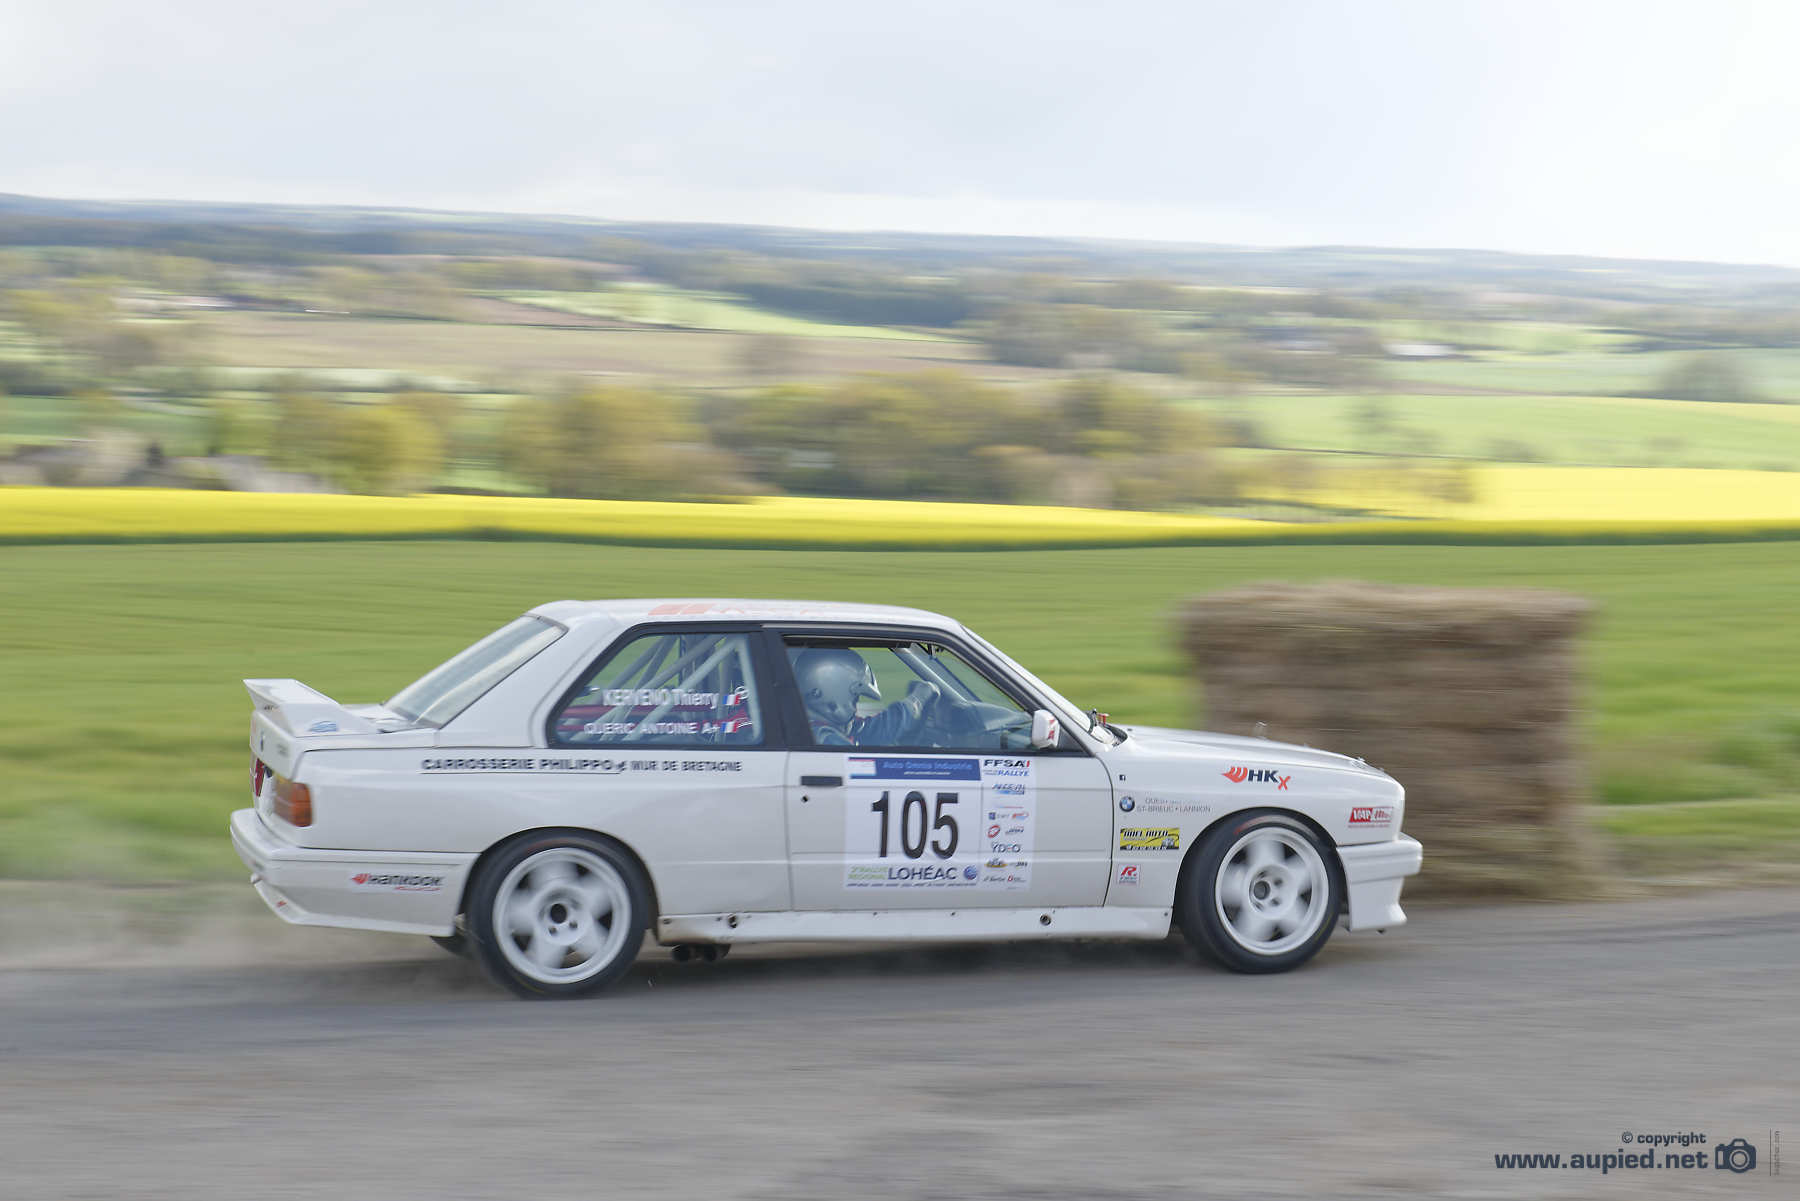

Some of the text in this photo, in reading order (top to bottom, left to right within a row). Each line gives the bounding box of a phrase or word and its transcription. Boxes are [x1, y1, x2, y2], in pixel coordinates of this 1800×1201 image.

[421, 758, 535, 770] CARROSSERIE
[662, 761, 677, 771] DE
[682, 761, 742, 772] BRETAGNE
[984, 759, 1025, 768] FFSA
[1179, 805, 1211, 813] LANNION
[871, 790, 959, 860] 105
[888, 865, 957, 880] LOHÉAC
